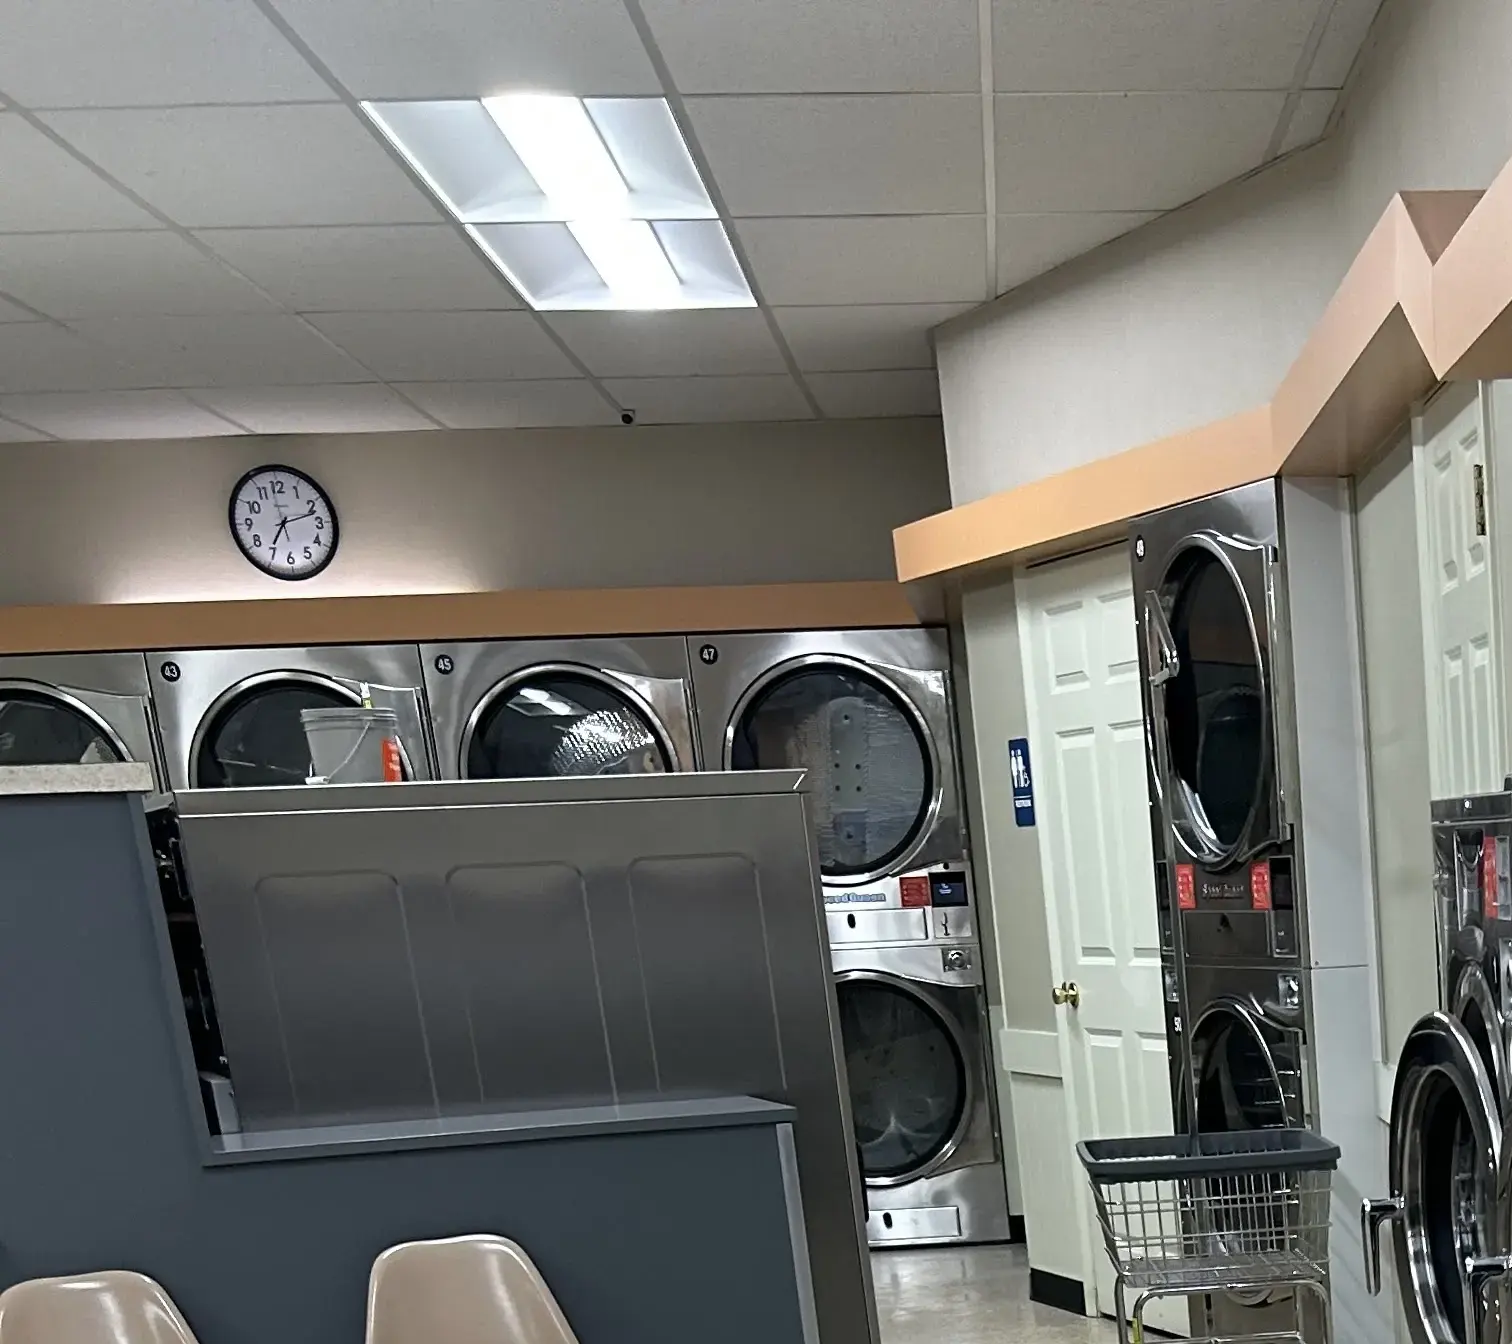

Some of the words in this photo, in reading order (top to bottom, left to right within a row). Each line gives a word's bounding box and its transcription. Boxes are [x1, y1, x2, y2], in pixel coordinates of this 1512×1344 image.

[256, 486, 269, 500] 11
[269, 480, 286, 494] 12
[293, 485, 300, 499] 1
[246, 500, 261, 514] 10
[306, 500, 316, 514] 2
[244, 517, 254, 531] 9
[314, 516, 325, 530] 3
[252, 533, 262, 547] 8
[313, 533, 322, 546] 4
[268, 547, 277, 560] 7
[286, 551, 296, 565] 6
[303, 546, 313, 560] 5
[702, 648, 715, 661] 47
[164, 665, 178, 678] 43
[438, 658, 452, 671] 45
